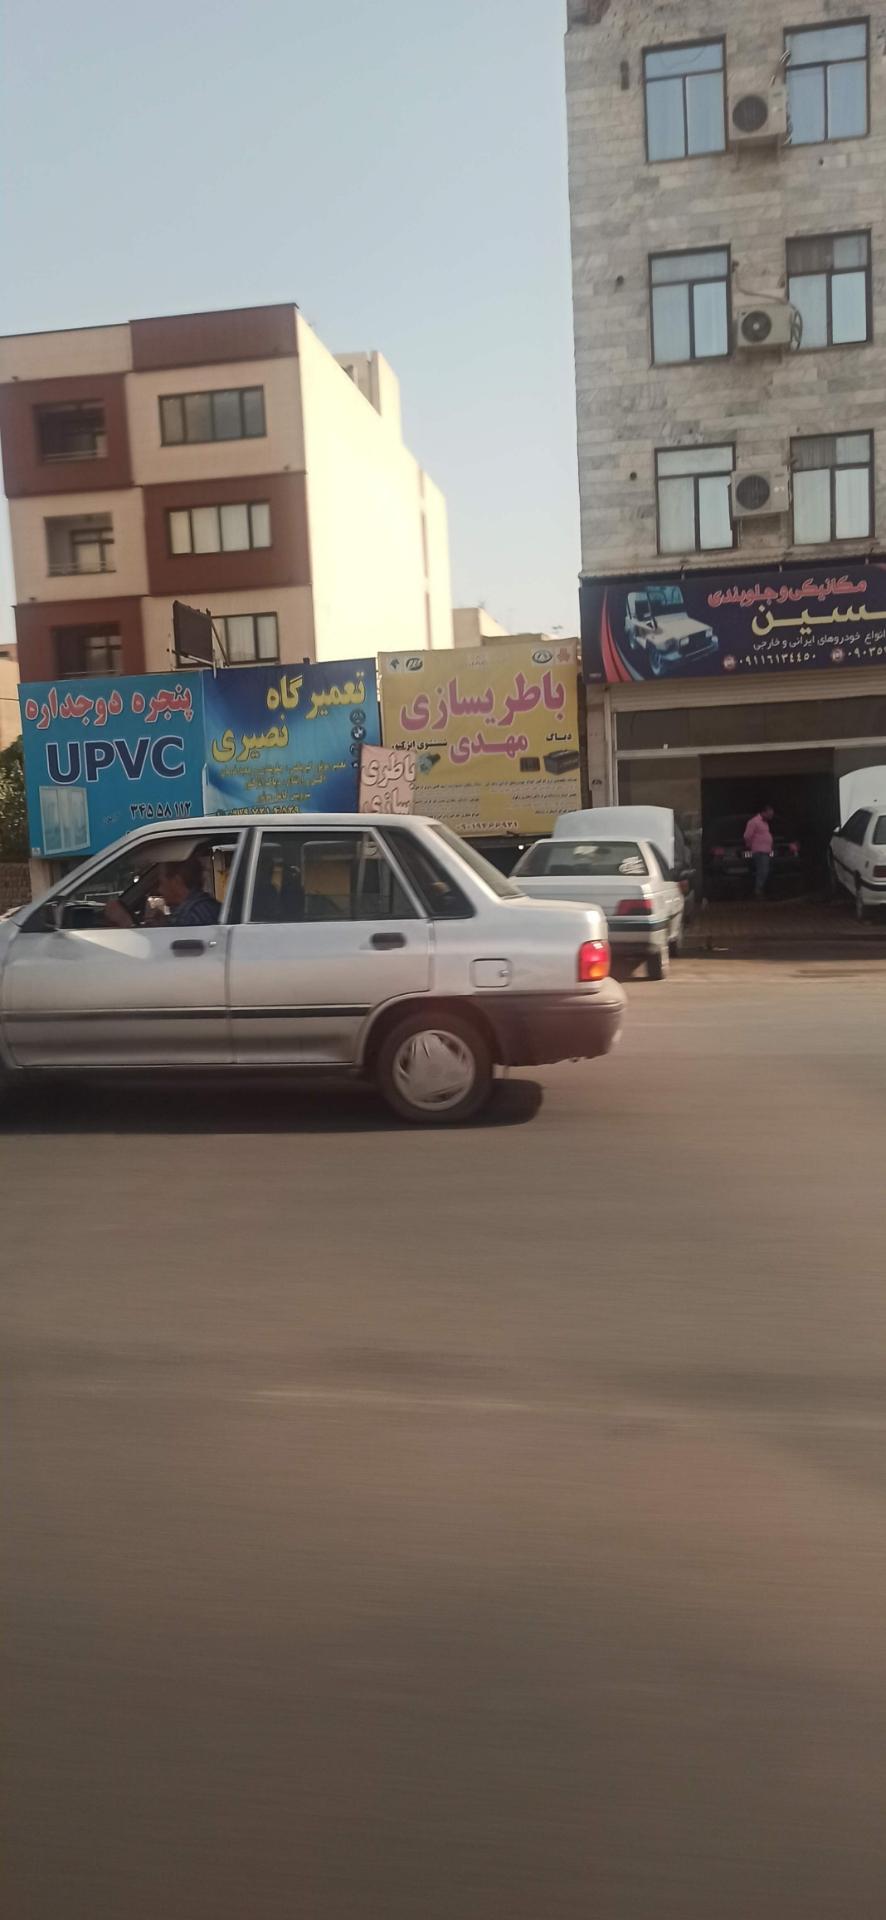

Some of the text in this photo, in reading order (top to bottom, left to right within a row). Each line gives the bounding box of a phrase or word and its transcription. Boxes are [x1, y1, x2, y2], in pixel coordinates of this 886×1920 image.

[751, 603, 886, 637] سین
[131, 684, 194, 723] پنجره
[212, 713, 290, 763] نصیری
[449, 730, 530, 765] مهدی
[46, 735, 186, 785] UPVC
[361, 751, 417, 791] باطری
